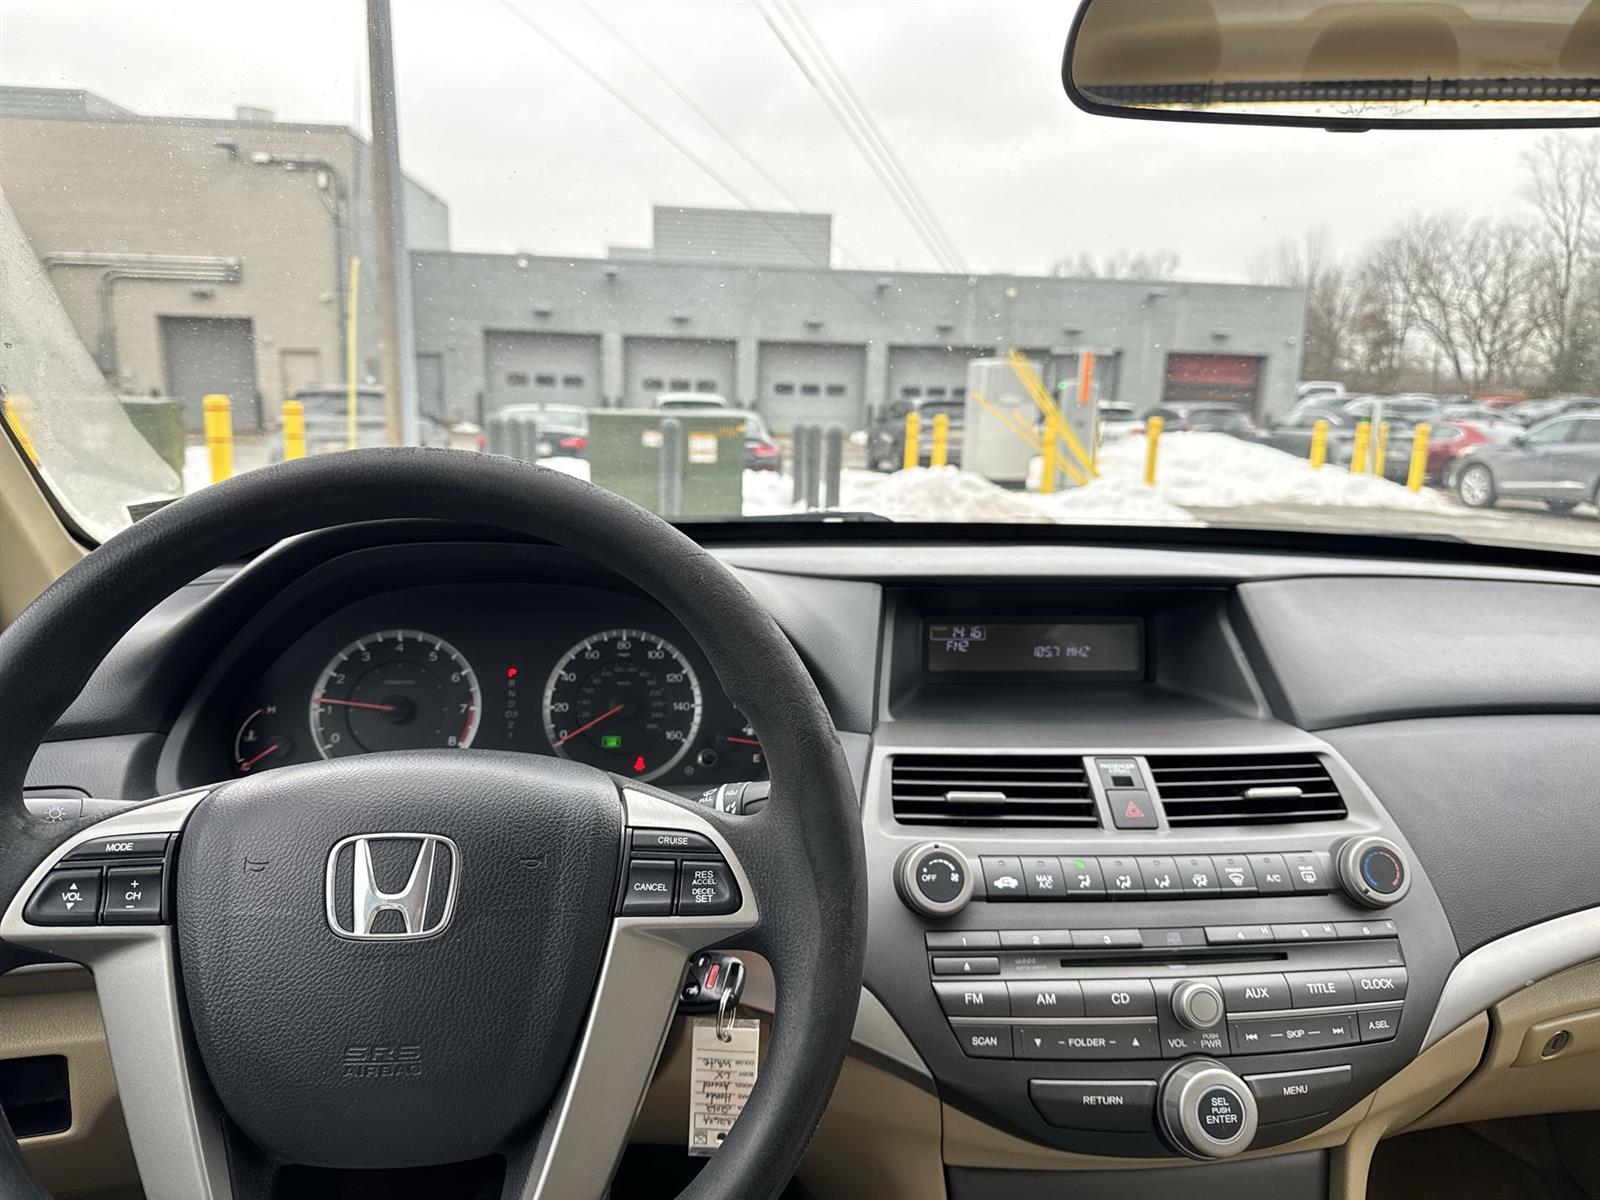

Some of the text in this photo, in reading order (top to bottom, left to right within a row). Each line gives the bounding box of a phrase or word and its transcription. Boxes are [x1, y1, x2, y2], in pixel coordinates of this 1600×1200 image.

[396, 642, 404, 652] 4
[617, 641, 631, 650] 80
[362, 652, 371, 661] 3
[429, 652, 438, 661] 5
[585, 650, 599, 659] 60
[648, 650, 664, 659] 100
[508, 668, 518, 678] P
[562, 673, 576, 682] 40
[666, 673, 683, 682] 120
[336, 674, 346, 684] 2
[451, 674, 460, 683] 6
[326, 706, 332, 714] 1
[459, 704, 467, 713] 7
[554, 702, 569, 712] 20
[673, 701, 689, 710] 140
[330, 732, 340, 743] 0
[665, 731, 683, 740] 160
[448, 736, 456, 746] 8
[657, 836, 688, 845] CRUISE
[106, 842, 134, 851] MODE
[694, 871, 714, 879] RES
[922, 873, 937, 882] OFF
[1035, 875, 1053, 883] MAX
[1266, 874, 1282, 883] A/C
[634, 883, 668, 892] CANCEL
[62, 892, 83, 901] VOL
[125, 891, 142, 900] CH
[695, 895, 713, 903] SET
[1363, 927, 1370, 935] 6
[962, 937, 967, 946] 1
[1032, 936, 1040, 945] 2
[1103, 935, 1112, 944] 3
[1306, 982, 1336, 994] TITLE
[1361, 978, 1395, 990] CLOCK
[1244, 987, 1269, 999] AUX
[964, 992, 984, 1004] FM
[1036, 993, 1057, 1005] AM
[1111, 992, 1130, 1004] CD
[1369, 1020, 1389, 1030] A.SEL
[1286, 1029, 1305, 1039] SKIP
[972, 1036, 997, 1046] SCAN
[1068, 1038, 1106, 1047] FOLDER
[1168, 1039, 1187, 1048] VOL
[1200, 1040, 1222, 1049] PWR
[343, 1065, 422, 1077] AIRBAG
[1283, 1085, 1308, 1096] MENU
[1082, 1096, 1123, 1105] RETURN
[1211, 1097, 1230, 1106] SEL
[1206, 1114, 1238, 1124] ENTER
